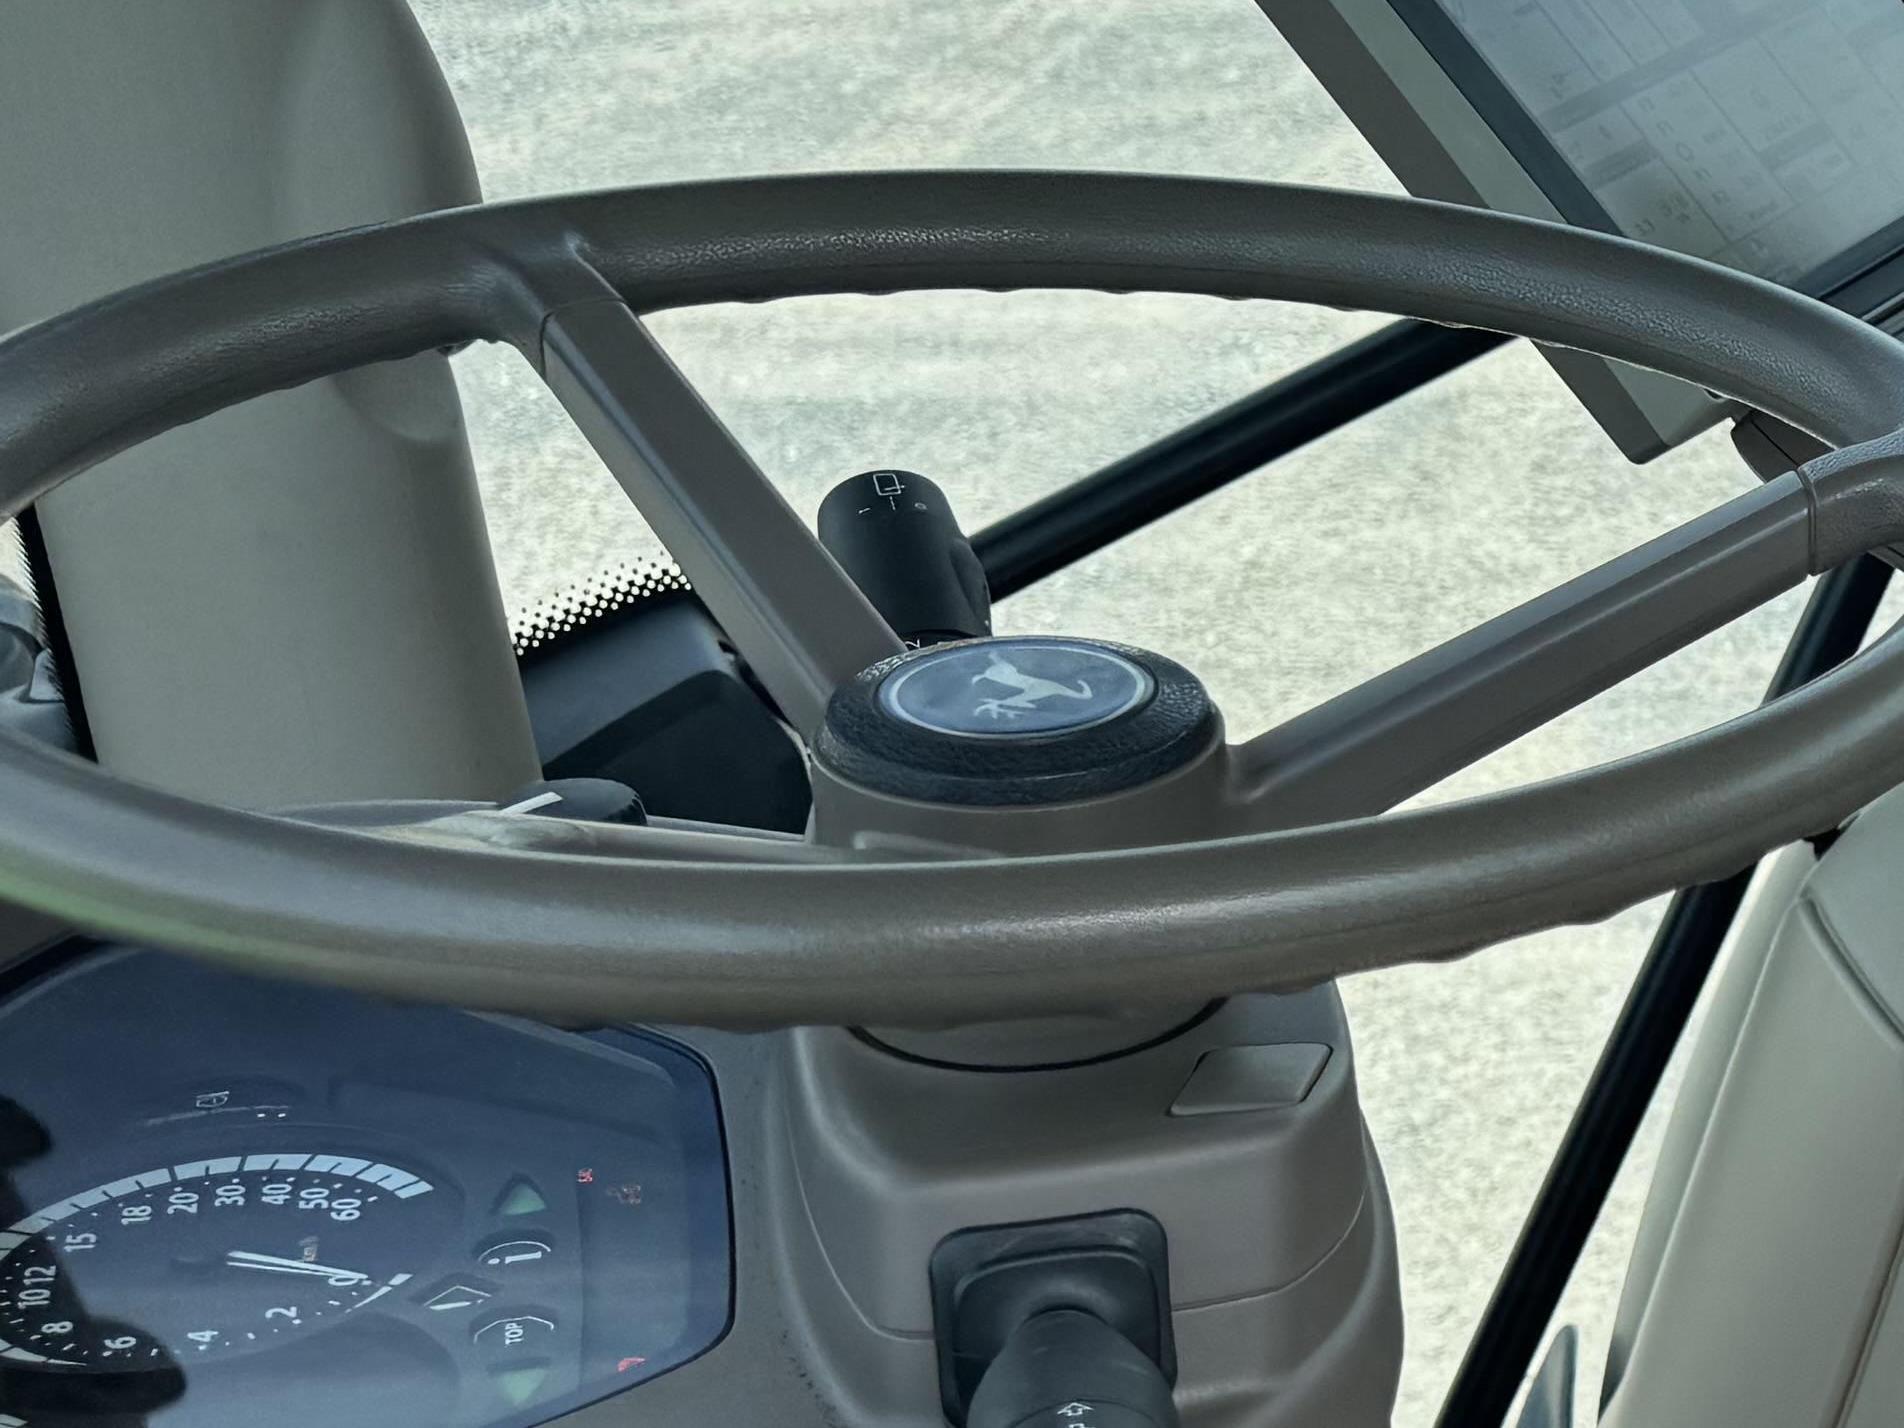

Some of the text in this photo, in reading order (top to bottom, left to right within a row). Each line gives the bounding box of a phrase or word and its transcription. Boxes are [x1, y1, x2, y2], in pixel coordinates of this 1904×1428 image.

[167, 1192, 199, 1214] 20
[214, 1185, 247, 1206] 30
[260, 1183, 293, 1205] 40
[299, 1187, 330, 1209] 50
[121, 1205, 152, 1225] 18
[330, 1198, 361, 1221] 60
[64, 1232, 98, 1252] 15
[23, 1265, 56, 1285] 12
[17, 1288, 51, 1309] 10
[265, 1306, 298, 1320] 2
[41, 1321, 74, 1334] 8
[187, 1329, 219, 1343] 4
[504, 1322, 524, 1349] TOP
[104, 1336, 137, 1350] 6
